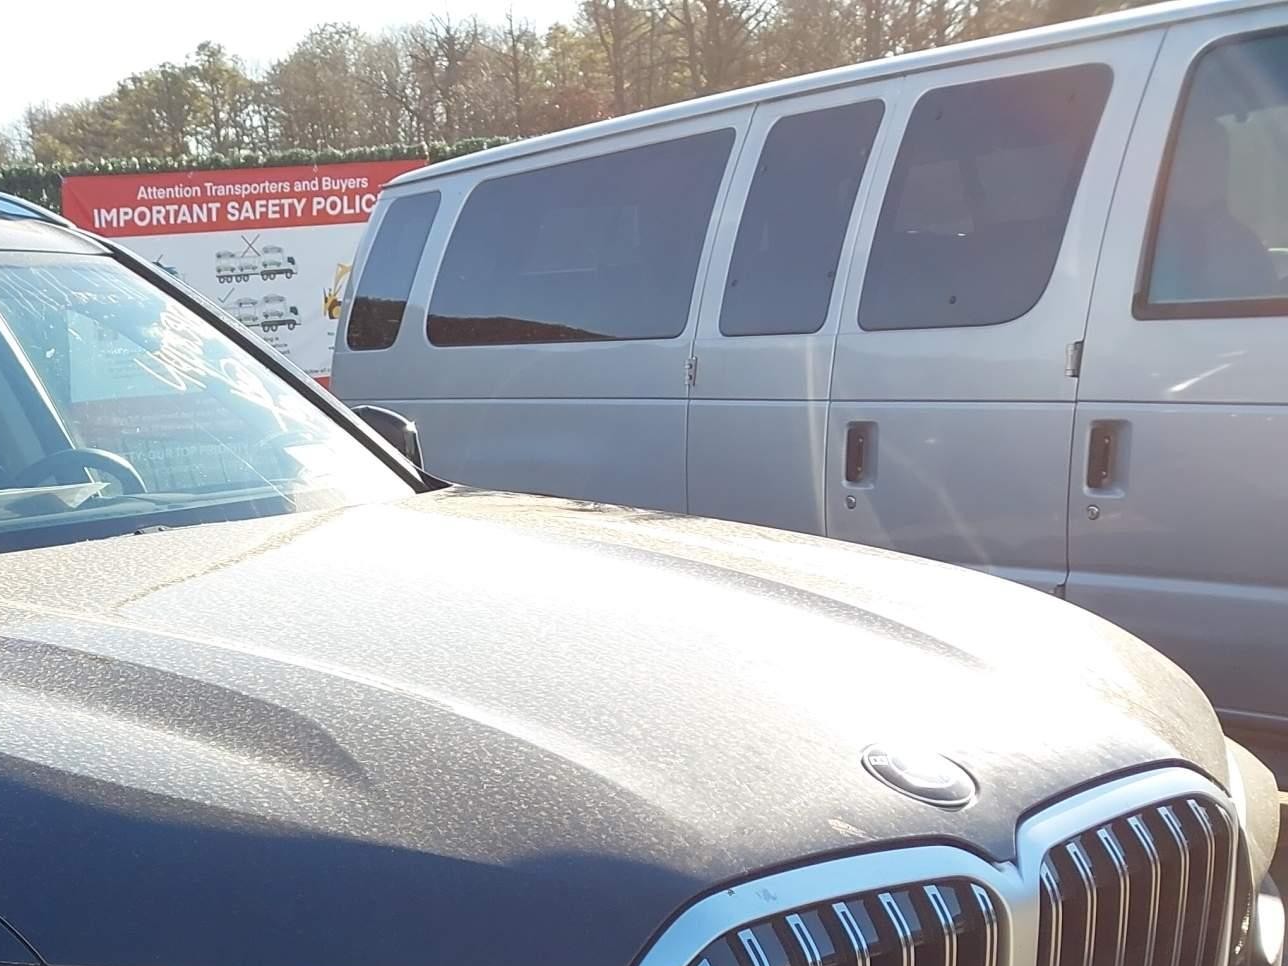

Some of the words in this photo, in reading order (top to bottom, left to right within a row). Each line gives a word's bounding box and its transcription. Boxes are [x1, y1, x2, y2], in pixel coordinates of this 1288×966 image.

[137, 185, 201, 201] Attention
[204, 180, 290, 199] Transporters
[294, 178, 319, 192] and
[322, 176, 369, 191] Buyers
[93, 203, 221, 229] IMPORTANT
[227, 197, 306, 222] SAFETY
[312, 192, 380, 216] POLIC
